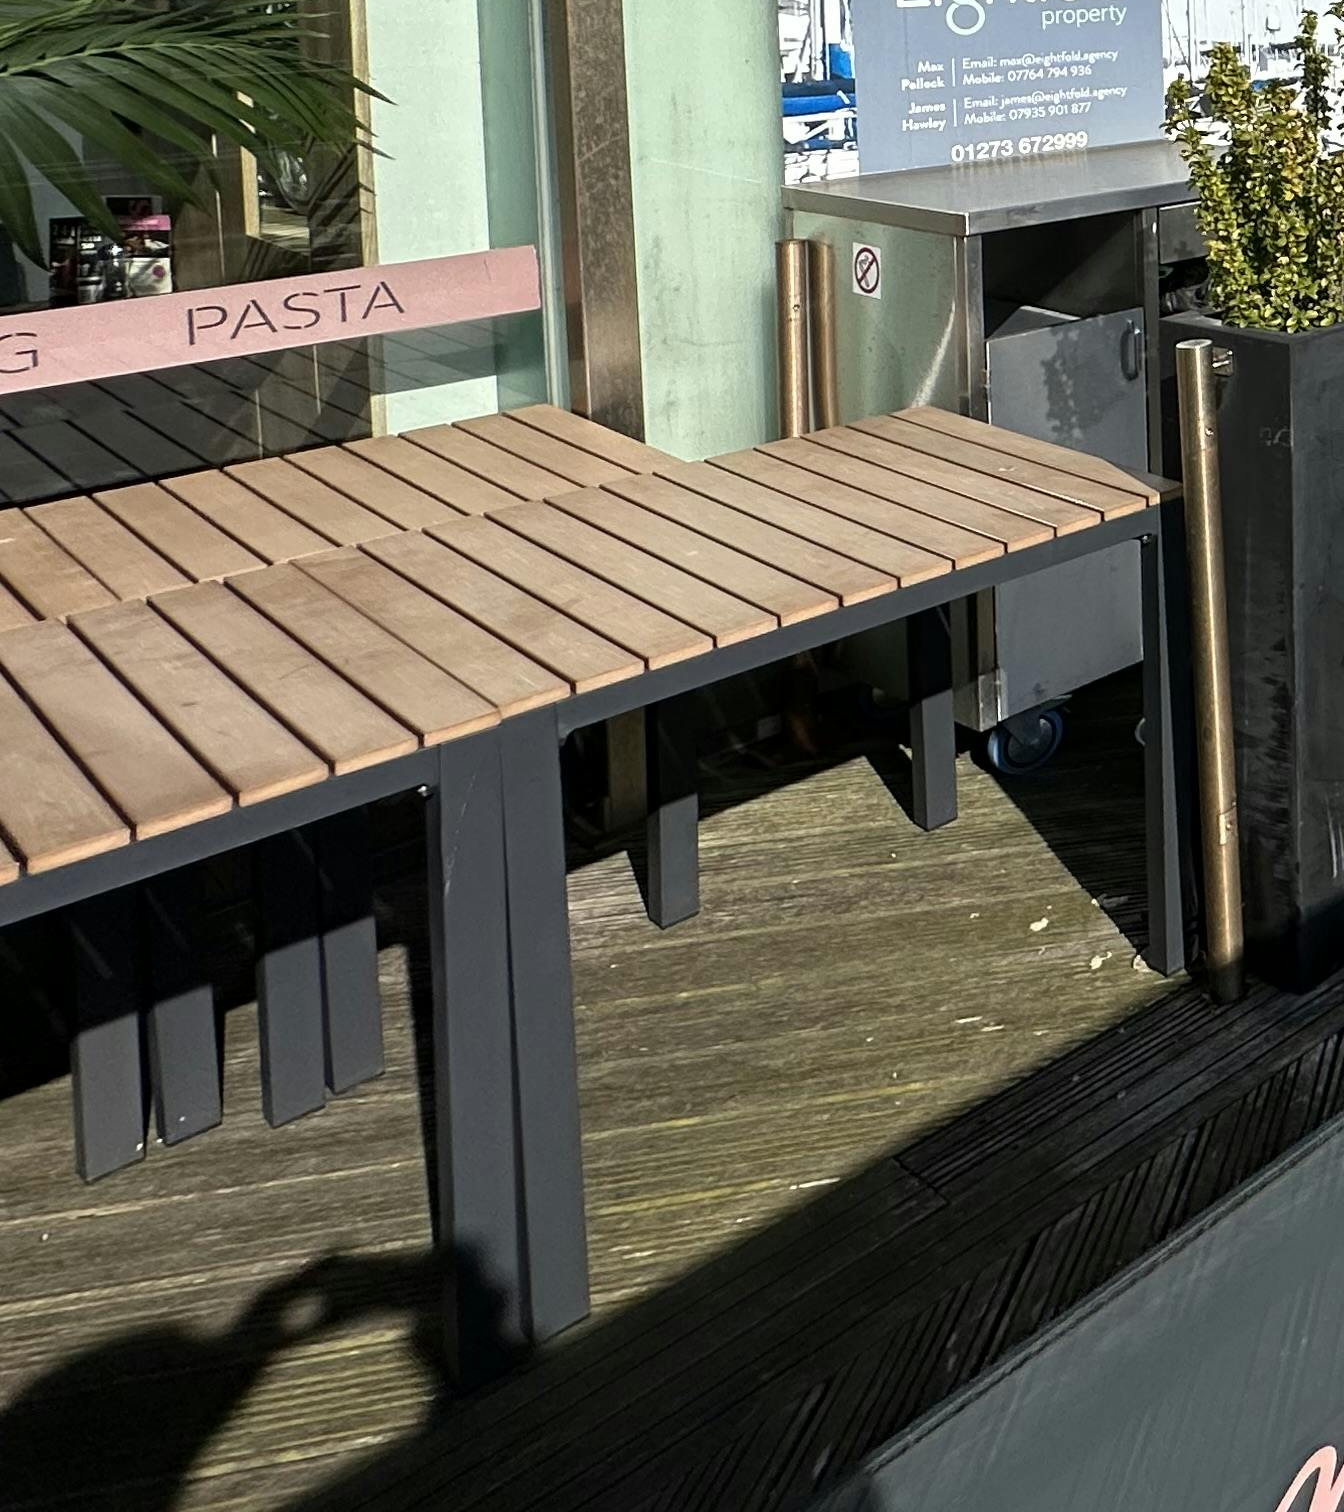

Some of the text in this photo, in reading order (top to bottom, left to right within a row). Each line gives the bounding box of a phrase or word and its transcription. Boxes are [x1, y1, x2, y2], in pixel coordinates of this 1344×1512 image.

[1041, 3, 1128, 31] property
[917, 61, 944, 73] Max
[962, 57, 997, 70] Email:
[962, 65, 1092, 85] Mobile: 07764 794 936
[908, 103, 946, 115] James
[964, 96, 999, 108] Email:
[963, 102, 1092, 125] Mobile: 07935 901 877
[901, 118, 946, 132] Hawley
[951, 131, 1088, 163] 01273 672999
[187, 280, 405, 346] PASTA
